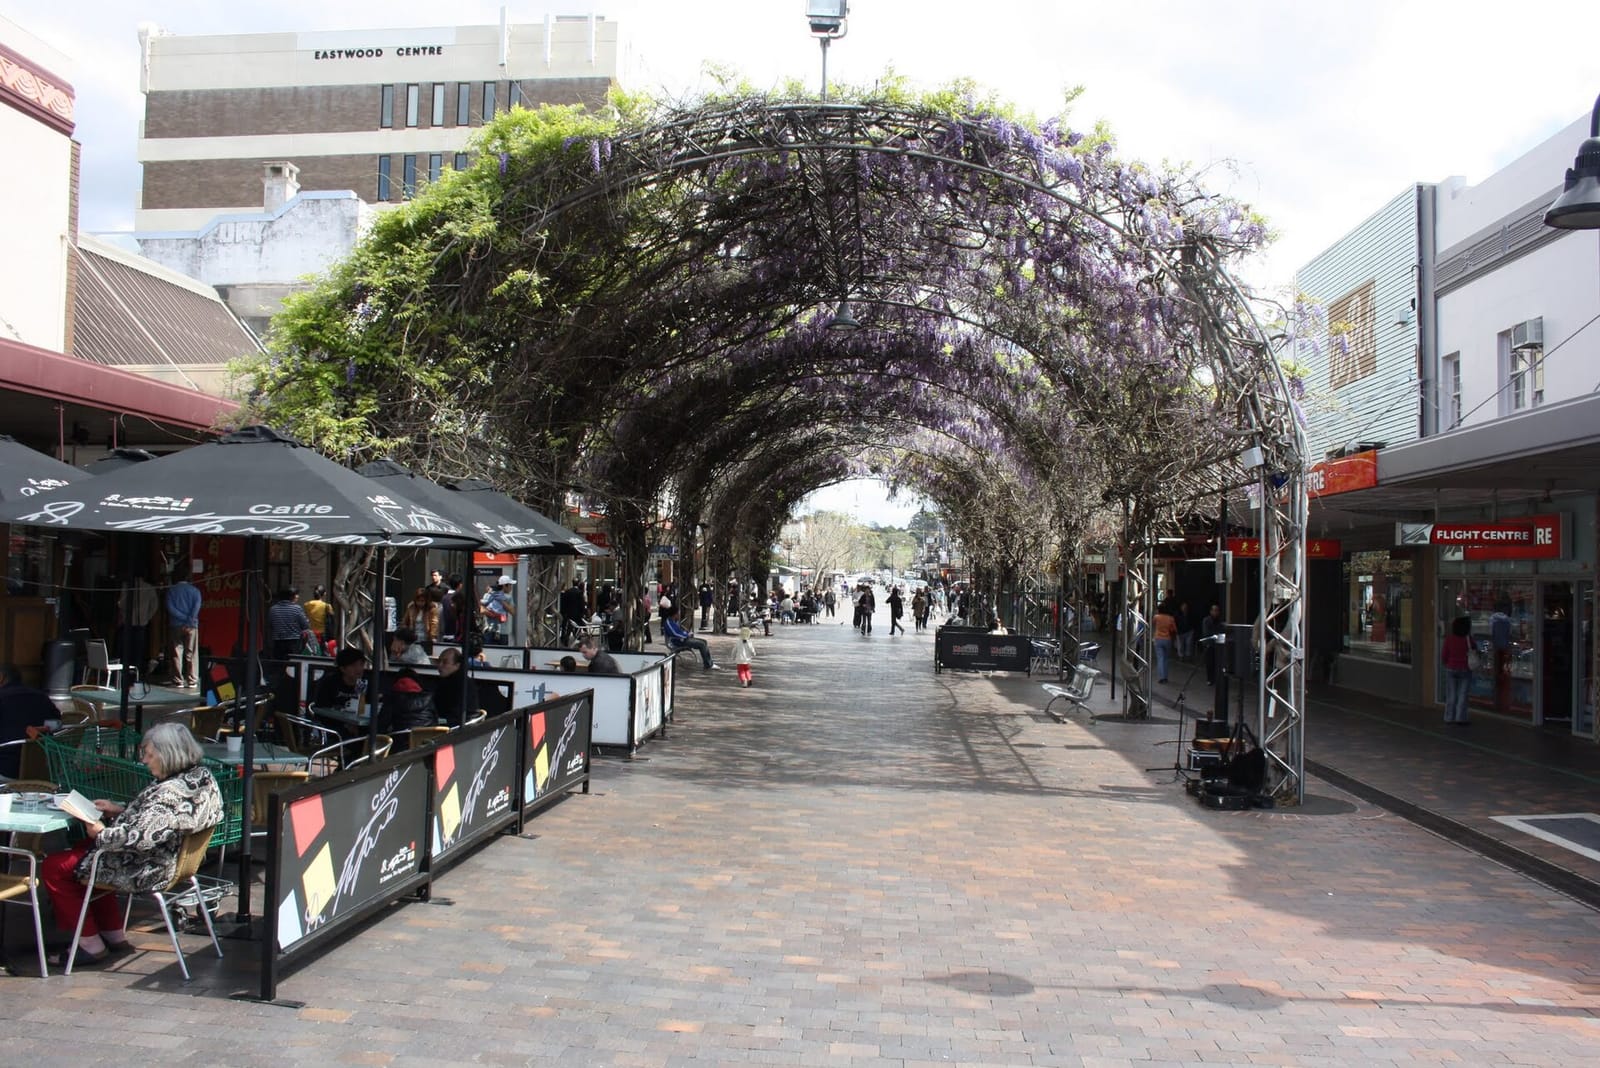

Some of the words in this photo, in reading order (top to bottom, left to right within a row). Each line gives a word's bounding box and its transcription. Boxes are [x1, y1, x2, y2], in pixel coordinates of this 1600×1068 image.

[314, 48, 384, 60] EASTWOOD
[396, 46, 443, 57] CENTRE
[248, 503, 333, 514] Caffe
[1436, 530, 1481, 539] FLIGHT
[1482, 530, 1529, 540] CENTRE
[371, 770, 399, 811] Caffe
